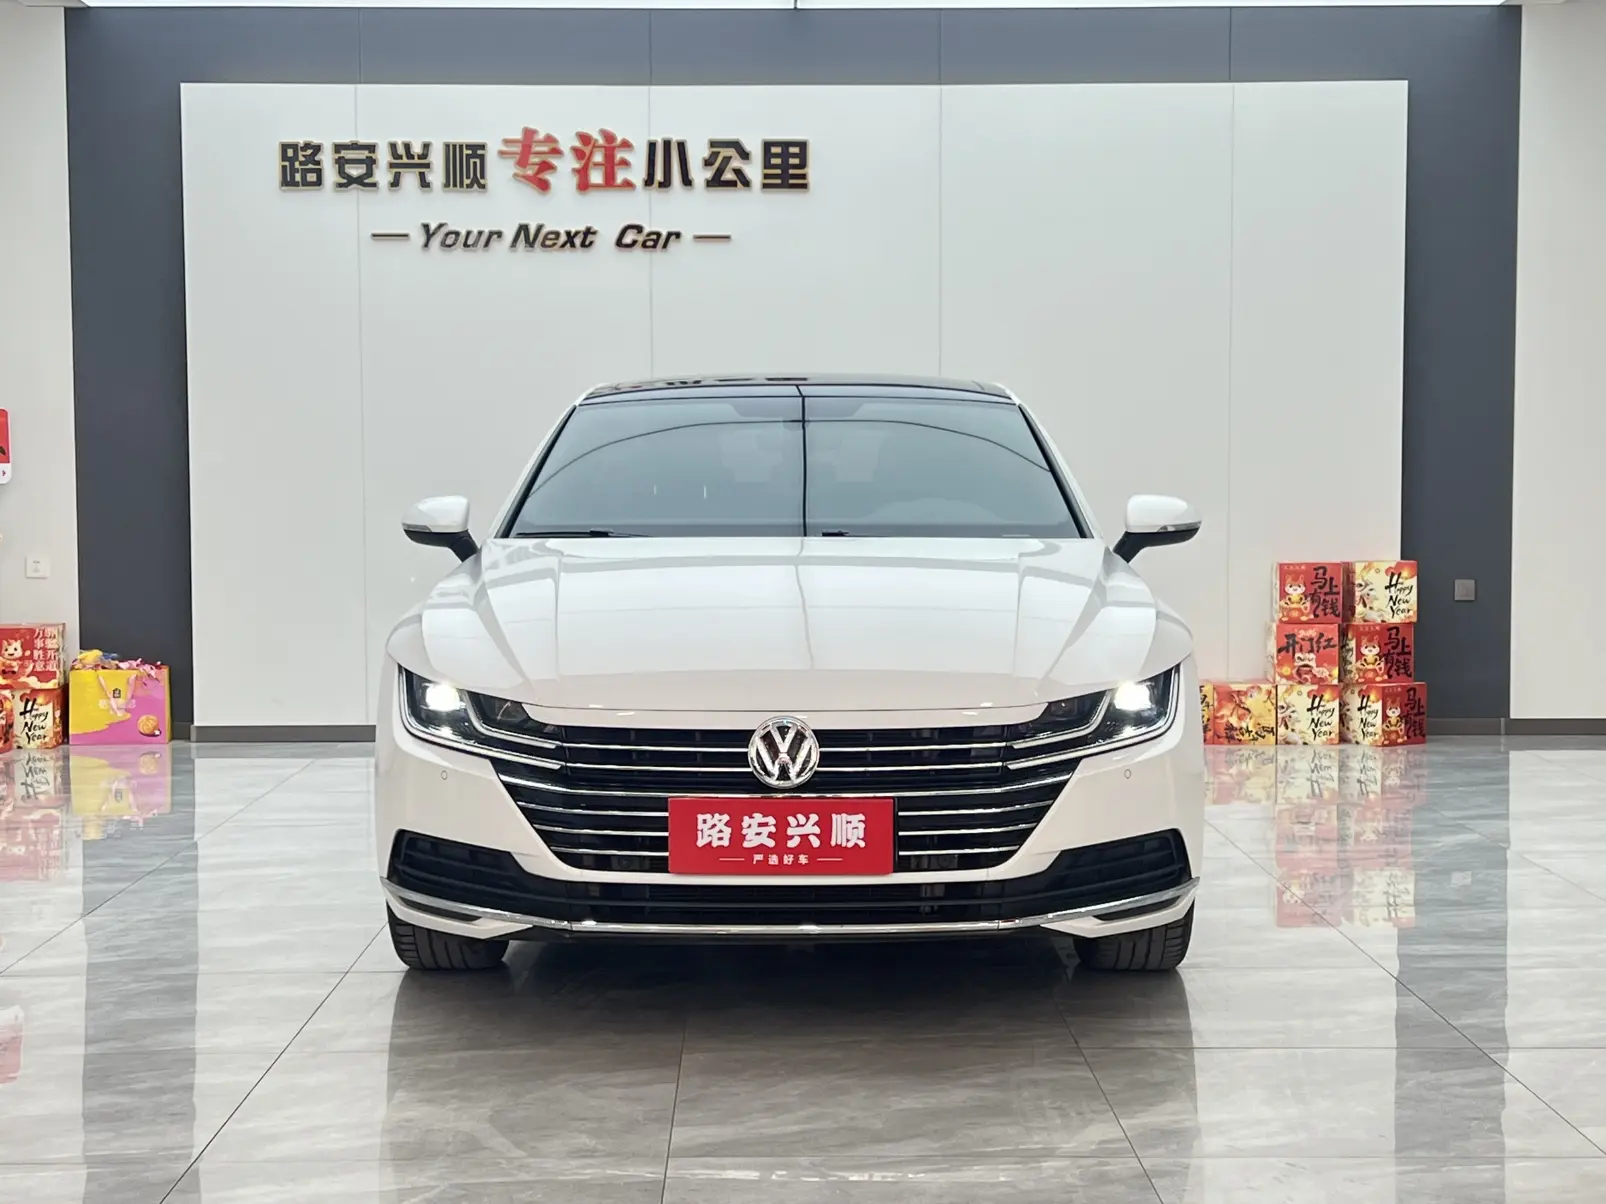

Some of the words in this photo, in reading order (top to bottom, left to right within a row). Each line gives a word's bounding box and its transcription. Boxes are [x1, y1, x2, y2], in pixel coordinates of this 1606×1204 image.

[279, 128, 810, 192] 路安兴顺专注小公里
[421, 223, 502, 252] Your
[510, 224, 598, 250] Next
[614, 224, 683, 250] Car
[1385, 571, 1413, 597] Happy
[1386, 594, 1410, 608] New
[1390, 605, 1411, 619] Year
[1278, 632, 1337, 660] 开门红
[20, 698, 48, 722] Happy
[1306, 694, 1335, 719] Happy
[21, 721, 46, 734] New
[1308, 717, 1332, 730] New
[25, 732, 47, 744] Year
[1311, 728, 1332, 741] Year
[696, 813, 867, 848] 路安兴顺
[753, 854, 809, 865] 严选好车
